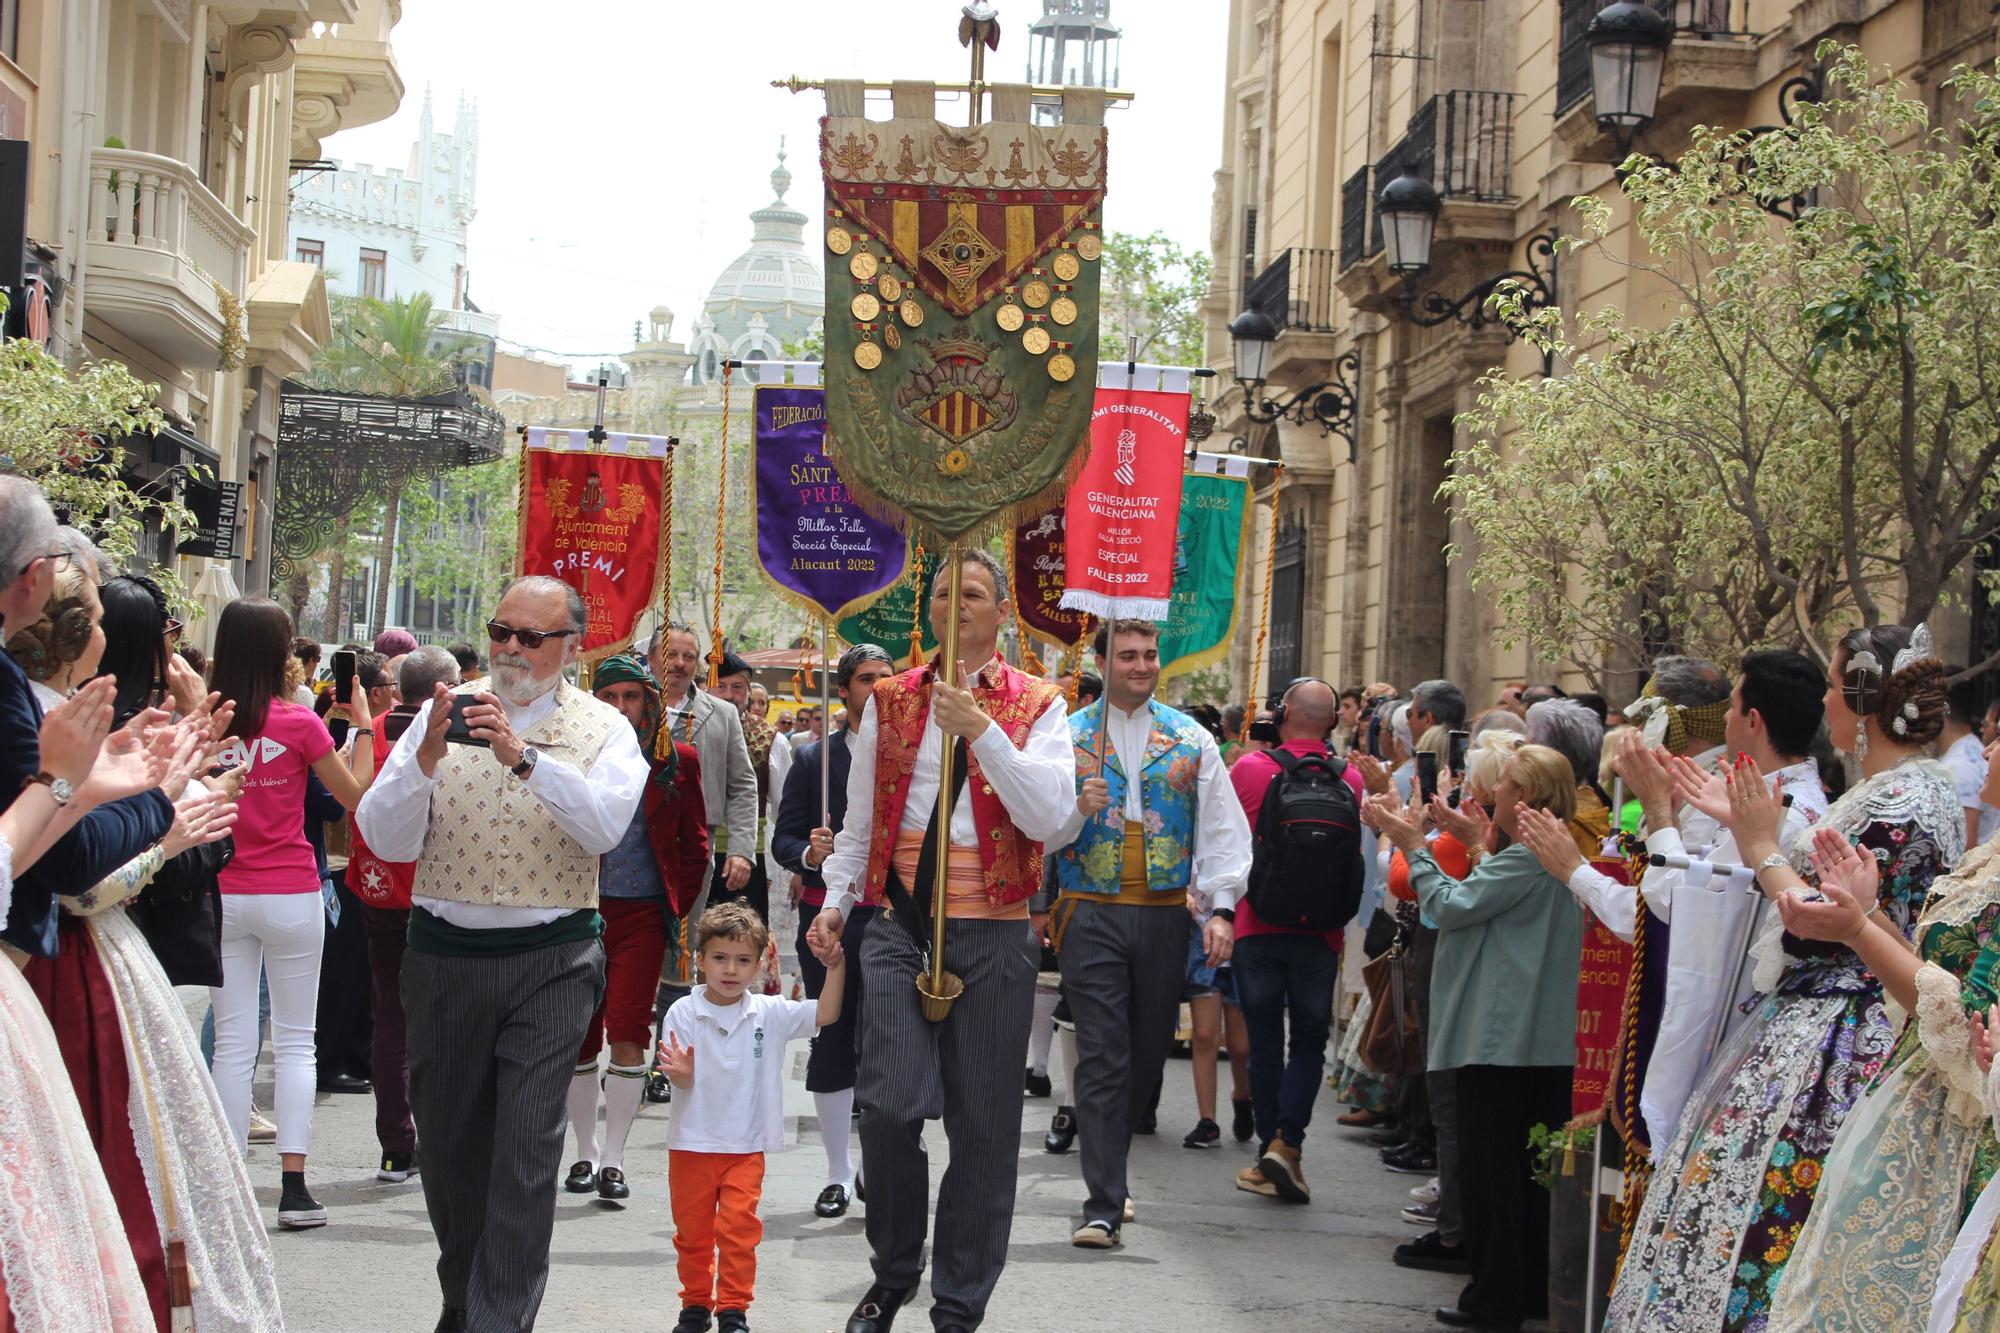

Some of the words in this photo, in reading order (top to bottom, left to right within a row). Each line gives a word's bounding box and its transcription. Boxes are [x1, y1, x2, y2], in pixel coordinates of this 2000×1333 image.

[772, 404, 822, 431] FEDERACIÓ
[1110, 404, 1182, 436] GENERALITAT
[804, 453, 816, 463] de
[790, 464, 832, 485] SANT
[1087, 491, 1160, 507] GENERALITAT
[1196, 495, 1230, 510] 2022
[825, 505, 831, 513] a
[834, 504, 843, 513] la
[1088, 503, 1156, 519] VALENCIANA
[214, 482, 238, 558] HOMENAJE
[556, 520, 629, 537] Ajuntament
[797, 516, 837, 532] Millor
[839, 516, 866, 533] Falla
[1098, 533, 1114, 544] FALLA
[1107, 527, 1132, 536] MILLOR
[554, 538, 570, 549] de
[792, 534, 827, 550] Secció
[830, 535, 872, 555] Especial
[790, 557, 841, 571] Alacant
[847, 558, 876, 571] 2022
[1098, 548, 1139, 564] ESPECIAL
[553, 551, 625, 582] PREMI
[1087, 566, 1123, 584] FALLES
[1125, 573, 1149, 584] 2022
[1037, 602, 1072, 623] FALLES
[859, 619, 898, 640] FALLES
[219, 738, 261, 774] ay
